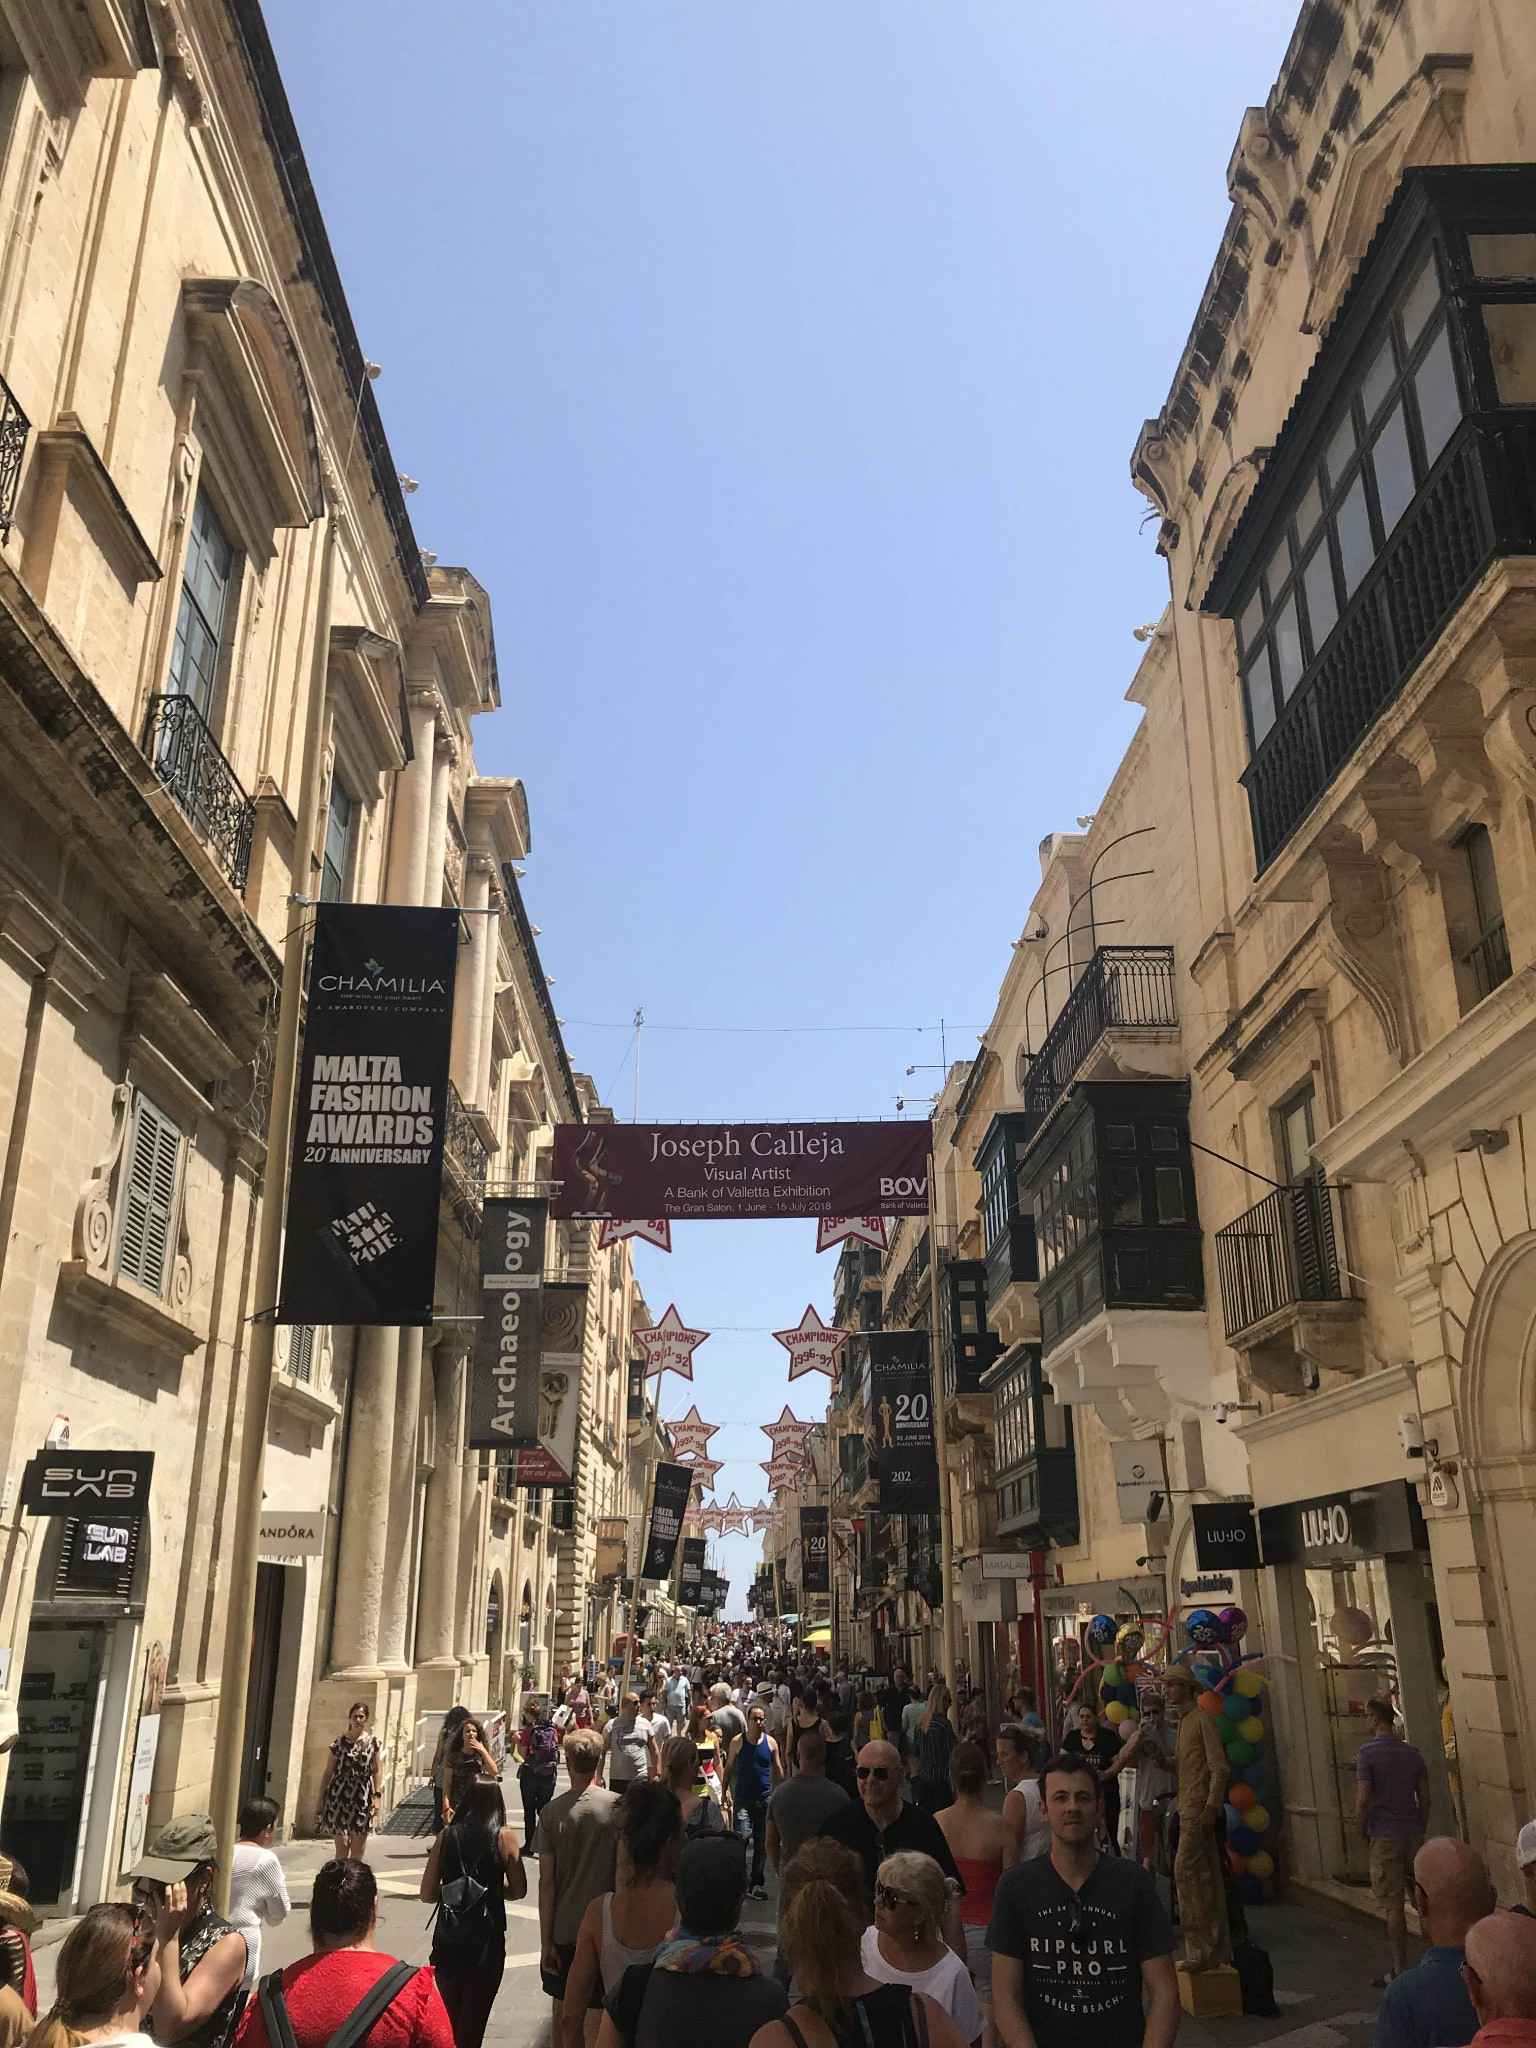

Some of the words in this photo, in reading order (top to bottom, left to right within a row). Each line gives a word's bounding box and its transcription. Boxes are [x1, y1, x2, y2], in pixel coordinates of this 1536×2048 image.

[318, 975, 446, 994] CHAMILIA
[313, 1055, 402, 1083] MALTA
[310, 1084, 431, 1113] FASHION
[306, 1113, 434, 1145] AWARDS
[650, 1130, 741, 1165] Joseph
[750, 1130, 846, 1163] Calleja
[329, 1148, 432, 1164] ANNIVERSARY
[703, 1167, 747, 1181] Visual
[751, 1166, 792, 1181] Artist
[664, 1187, 674, 1198] A
[677, 1186, 708, 1198] Bank
[711, 1186, 725, 1199] of
[726, 1186, 770, 1199] Valletta
[773, 1184, 831, 1198] Exhibition
[880, 1176, 928, 1197] BOV
[664, 1203, 681, 1213] The
[682, 1203, 704, 1214] Gran
[745, 1202, 767, 1212] June
[788, 1201, 806, 1215] July
[808, 1201, 832, 1212] 2018
[880, 1201, 897, 1209] Bank
[644, 1330, 697, 1345] CHAMPIONS
[786, 1330, 839, 1346] CHAMPIONS
[793, 1347, 833, 1368] 1996-97
[873, 1361, 927, 1373] CHAMILIA
[890, 1471, 912, 1483] 202
[41, 1482, 136, 1499] LAB
[83, 1543, 128, 1564] LAB
[1037, 1907, 1053, 1918] THE
[1082, 1905, 1117, 1920] ANNUAL
[1056, 1960, 1102, 1976] PRO
[1044, 1994, 1076, 2013] BELLS
[1082, 1996, 1120, 2014] BEACH
